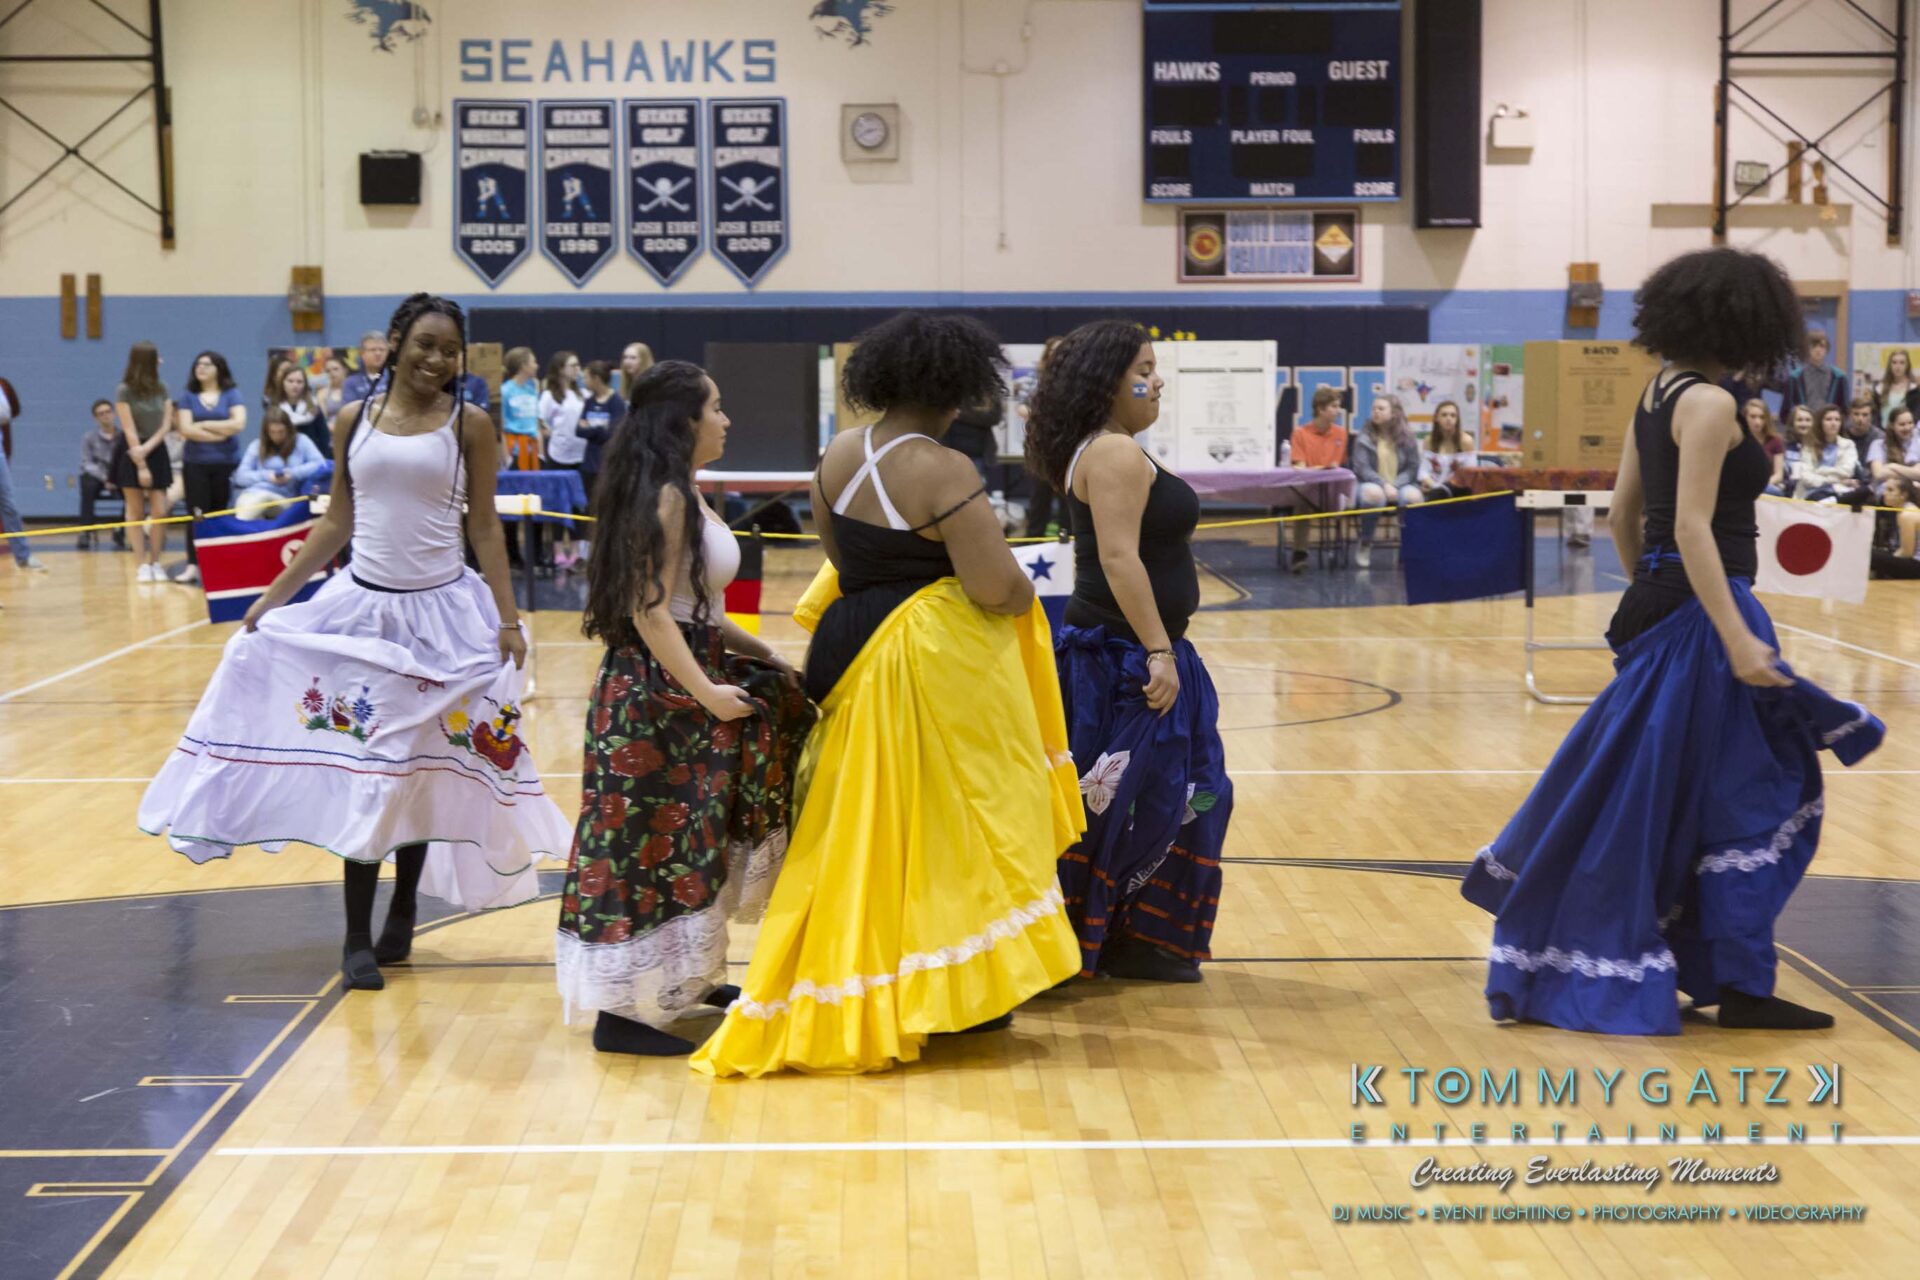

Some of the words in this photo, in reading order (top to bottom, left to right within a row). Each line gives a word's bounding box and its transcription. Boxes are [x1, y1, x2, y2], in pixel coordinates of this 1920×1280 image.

[460, 39, 777, 83] SEAHAWKS
[1153, 61, 1221, 82] HAWKS
[1328, 60, 1390, 81] GUEST
[1249, 71, 1297, 87] PERIOD
[1150, 129, 1193, 145] FOULS
[1231, 129, 1280, 144] PLAYER
[1282, 129, 1316, 144] FOUL
[1353, 128, 1396, 144] FOULS
[1150, 183, 1193, 198] SCORE
[1249, 182, 1296, 197] MATCH
[1353, 181, 1396, 197] SCORE
